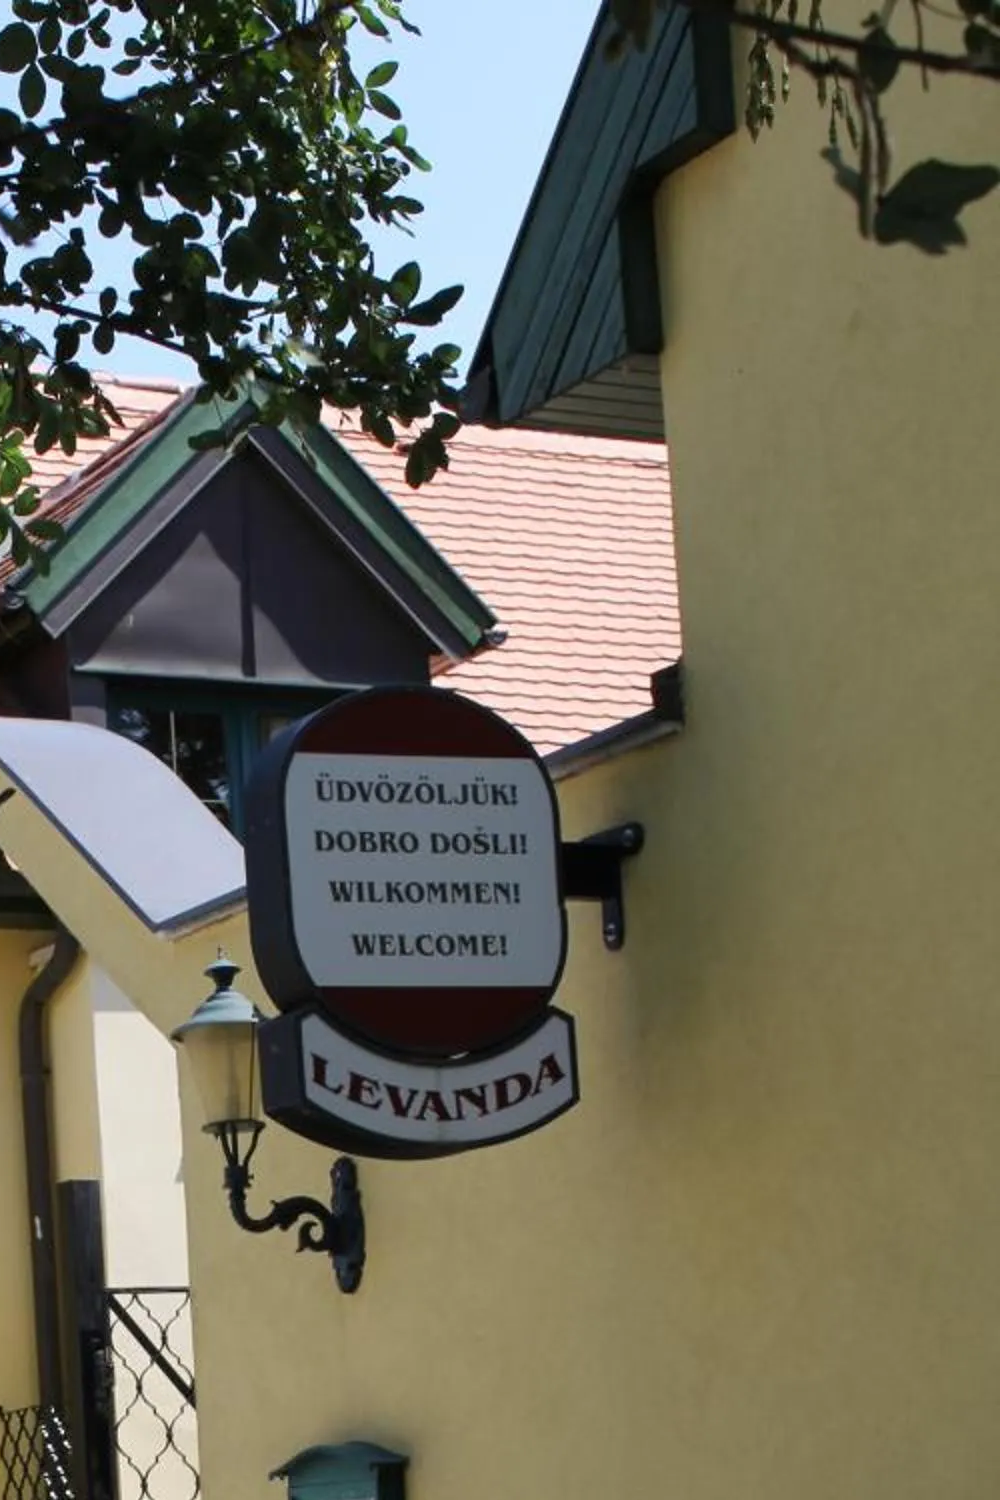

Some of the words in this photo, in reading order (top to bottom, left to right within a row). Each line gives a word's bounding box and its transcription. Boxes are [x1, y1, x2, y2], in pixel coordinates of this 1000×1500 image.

[315, 772, 519, 806] ÜDVÖZÖLJÜK!
[314, 829, 419, 854] DOBRO
[430, 826, 528, 855] DOŠLI!
[328, 880, 521, 905] WILKOMMEN!
[352, 933, 508, 957] WELCOME!
[310, 1052, 566, 1122] LEVANDA
